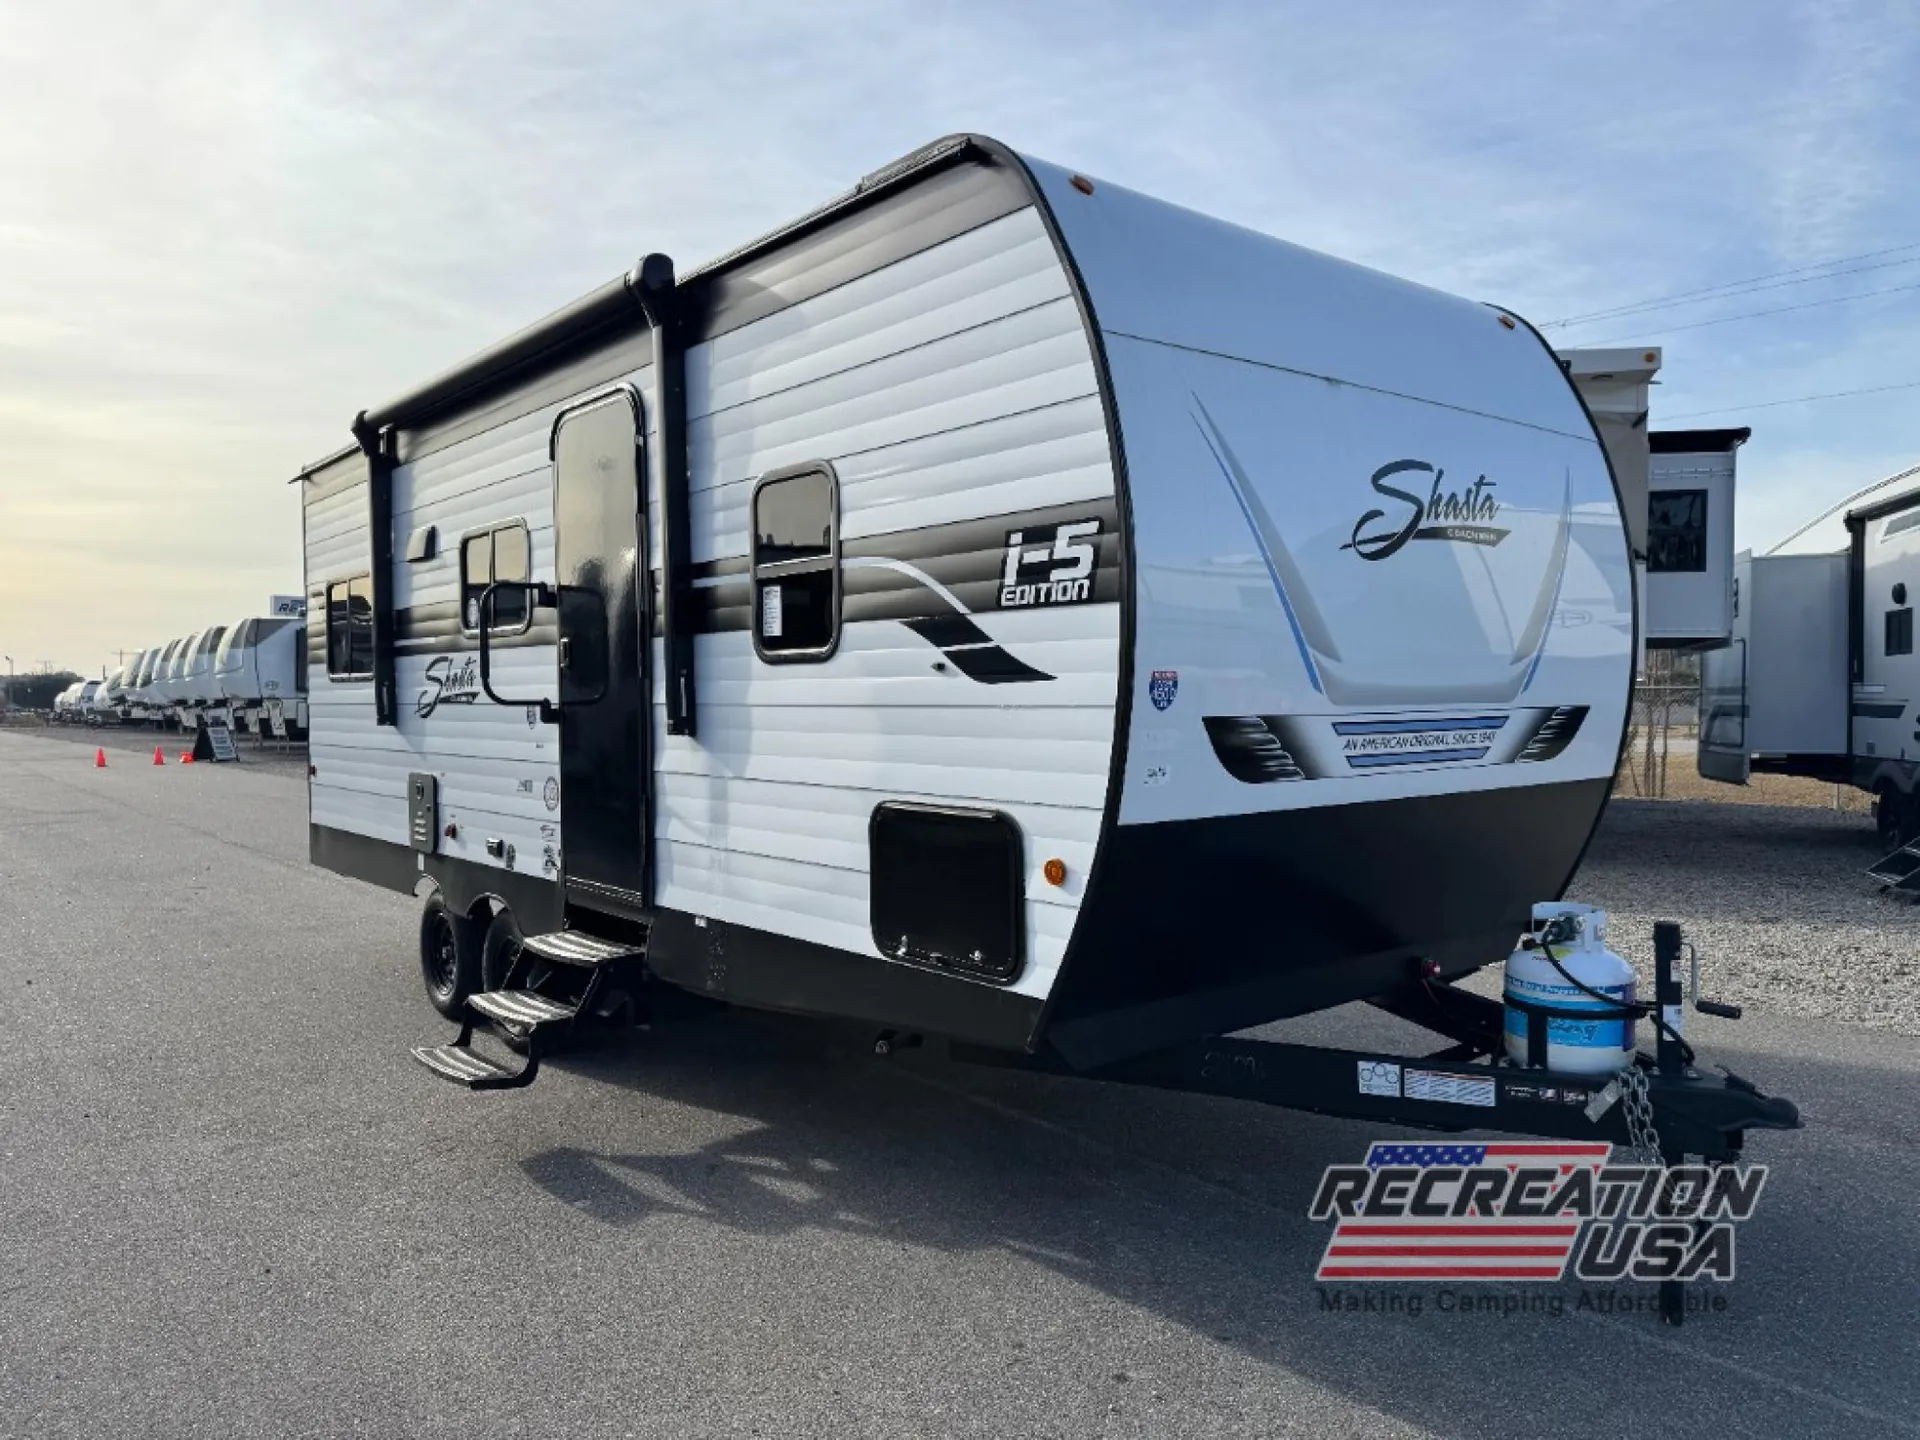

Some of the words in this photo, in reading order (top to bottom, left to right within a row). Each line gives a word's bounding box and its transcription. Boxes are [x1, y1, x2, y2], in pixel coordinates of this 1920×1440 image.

[1345, 459, 1500, 561] Shasta
[1001, 579, 1090, 606] EDITION
[416, 656, 477, 718] Shasta
[1343, 738, 1357, 750] AN
[1360, 736, 1408, 750] AMERICAN
[1409, 734, 1450, 747] ORIGINAL
[1451, 732, 1477, 745] SINCE
